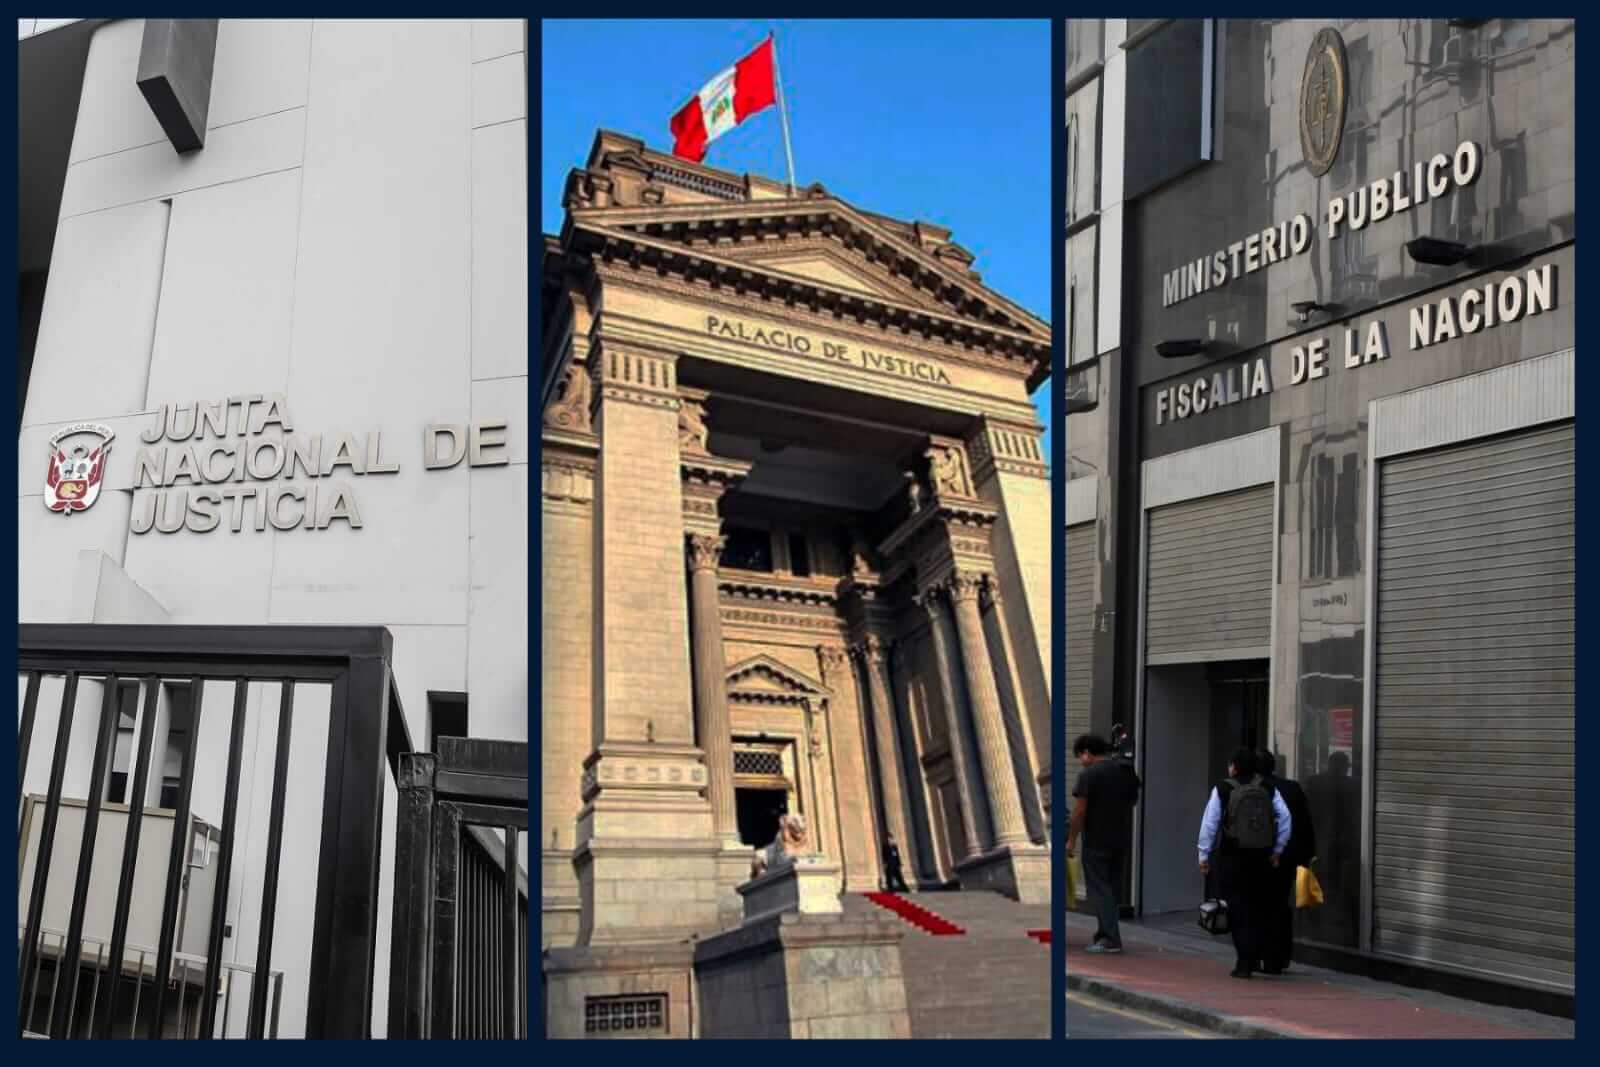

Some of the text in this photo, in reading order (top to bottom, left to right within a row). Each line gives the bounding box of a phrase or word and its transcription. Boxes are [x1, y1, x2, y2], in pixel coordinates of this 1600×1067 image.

[1162, 140, 1482, 306] MINISTERIO PUBLICO
[707, 315, 811, 353] PALACIO
[822, 341, 850, 362] DE
[1156, 263, 1558, 425] FISCALIA DE LA NACION
[141, 394, 293, 444] JUNTA
[133, 419, 510, 489] NACIONAL DE
[130, 482, 363, 534] JUSTICIA
